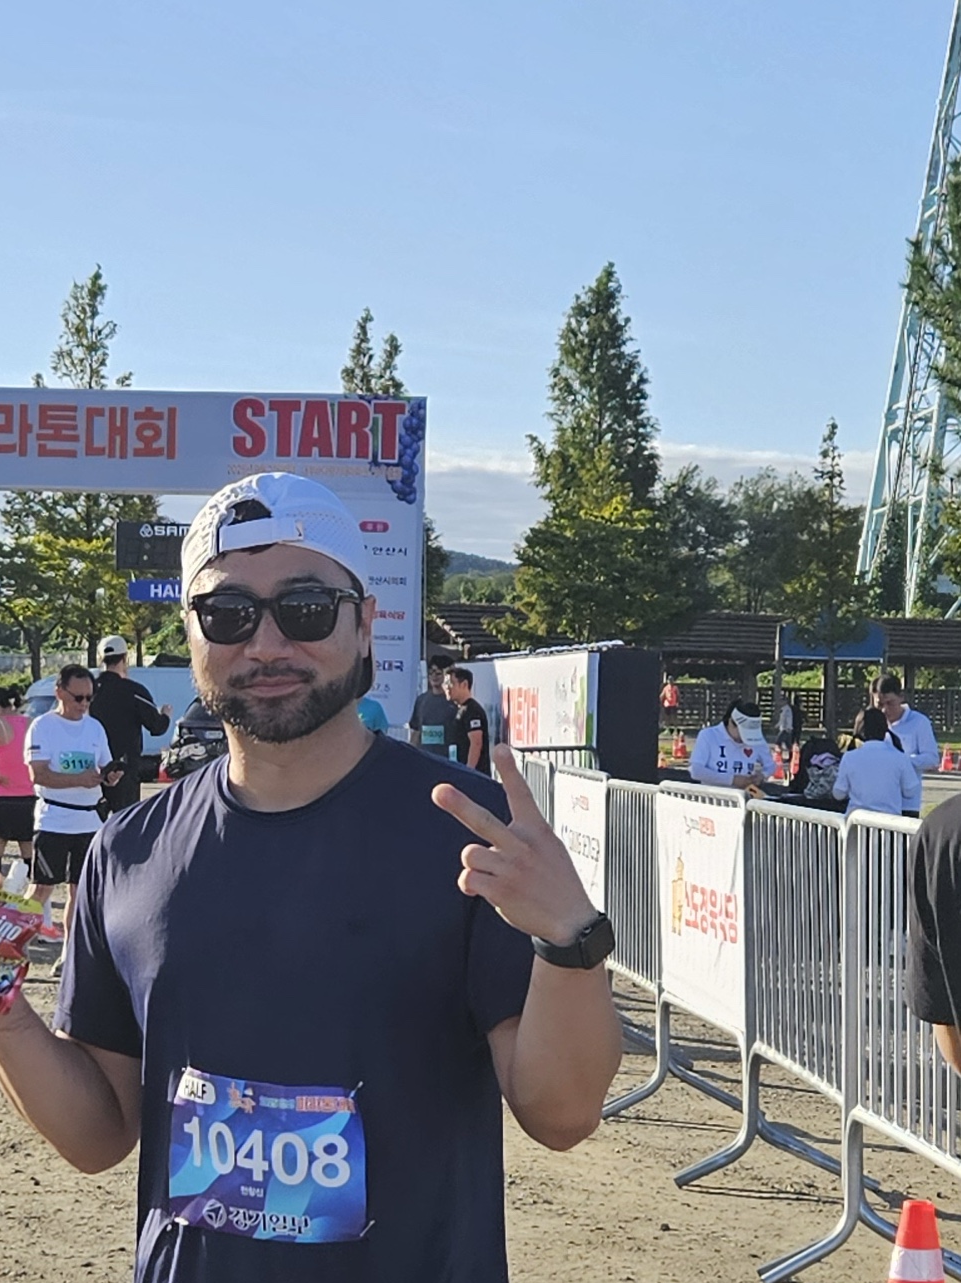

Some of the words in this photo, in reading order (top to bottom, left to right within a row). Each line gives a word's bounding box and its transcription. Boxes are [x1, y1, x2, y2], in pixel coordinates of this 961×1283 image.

[232, 397, 407, 461] START
[154, 525, 192, 537] SAM
[149, 583, 182, 598] HAL
[375, 609, 405, 620] 육식당
[184, 1081, 207, 1100] HALF
[183, 1115, 351, 1188] 10408
[228, 1205, 312, 1235] 경기일보
